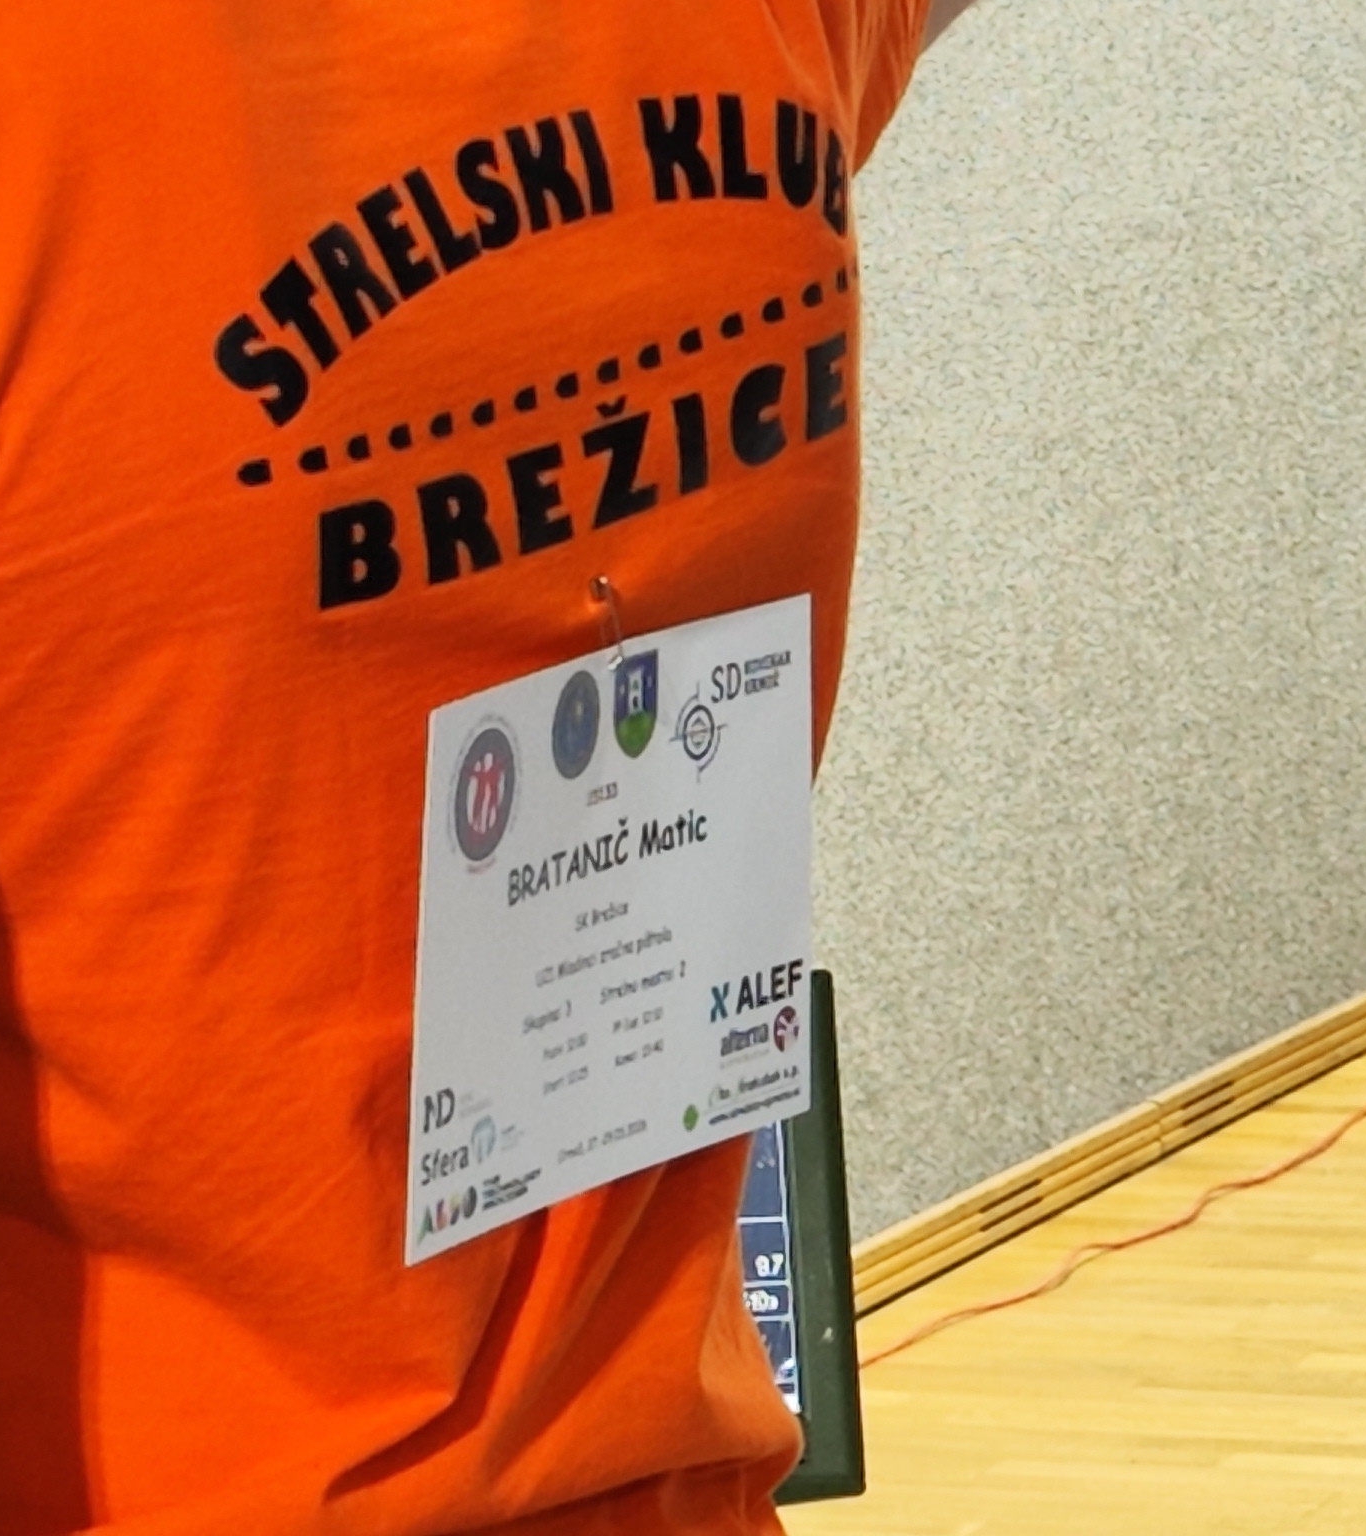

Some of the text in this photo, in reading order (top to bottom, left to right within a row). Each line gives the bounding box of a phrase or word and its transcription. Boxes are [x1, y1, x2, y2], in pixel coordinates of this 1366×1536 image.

[213, 109, 614, 427] STRELSKI
[317, 332, 848, 611] BREŽICE
[711, 662, 742, 703] SD
[508, 809, 707, 907] BRATANIČ Matic
[736, 958, 804, 1015] ALEF
[421, 1145, 470, 1186] Sfera
